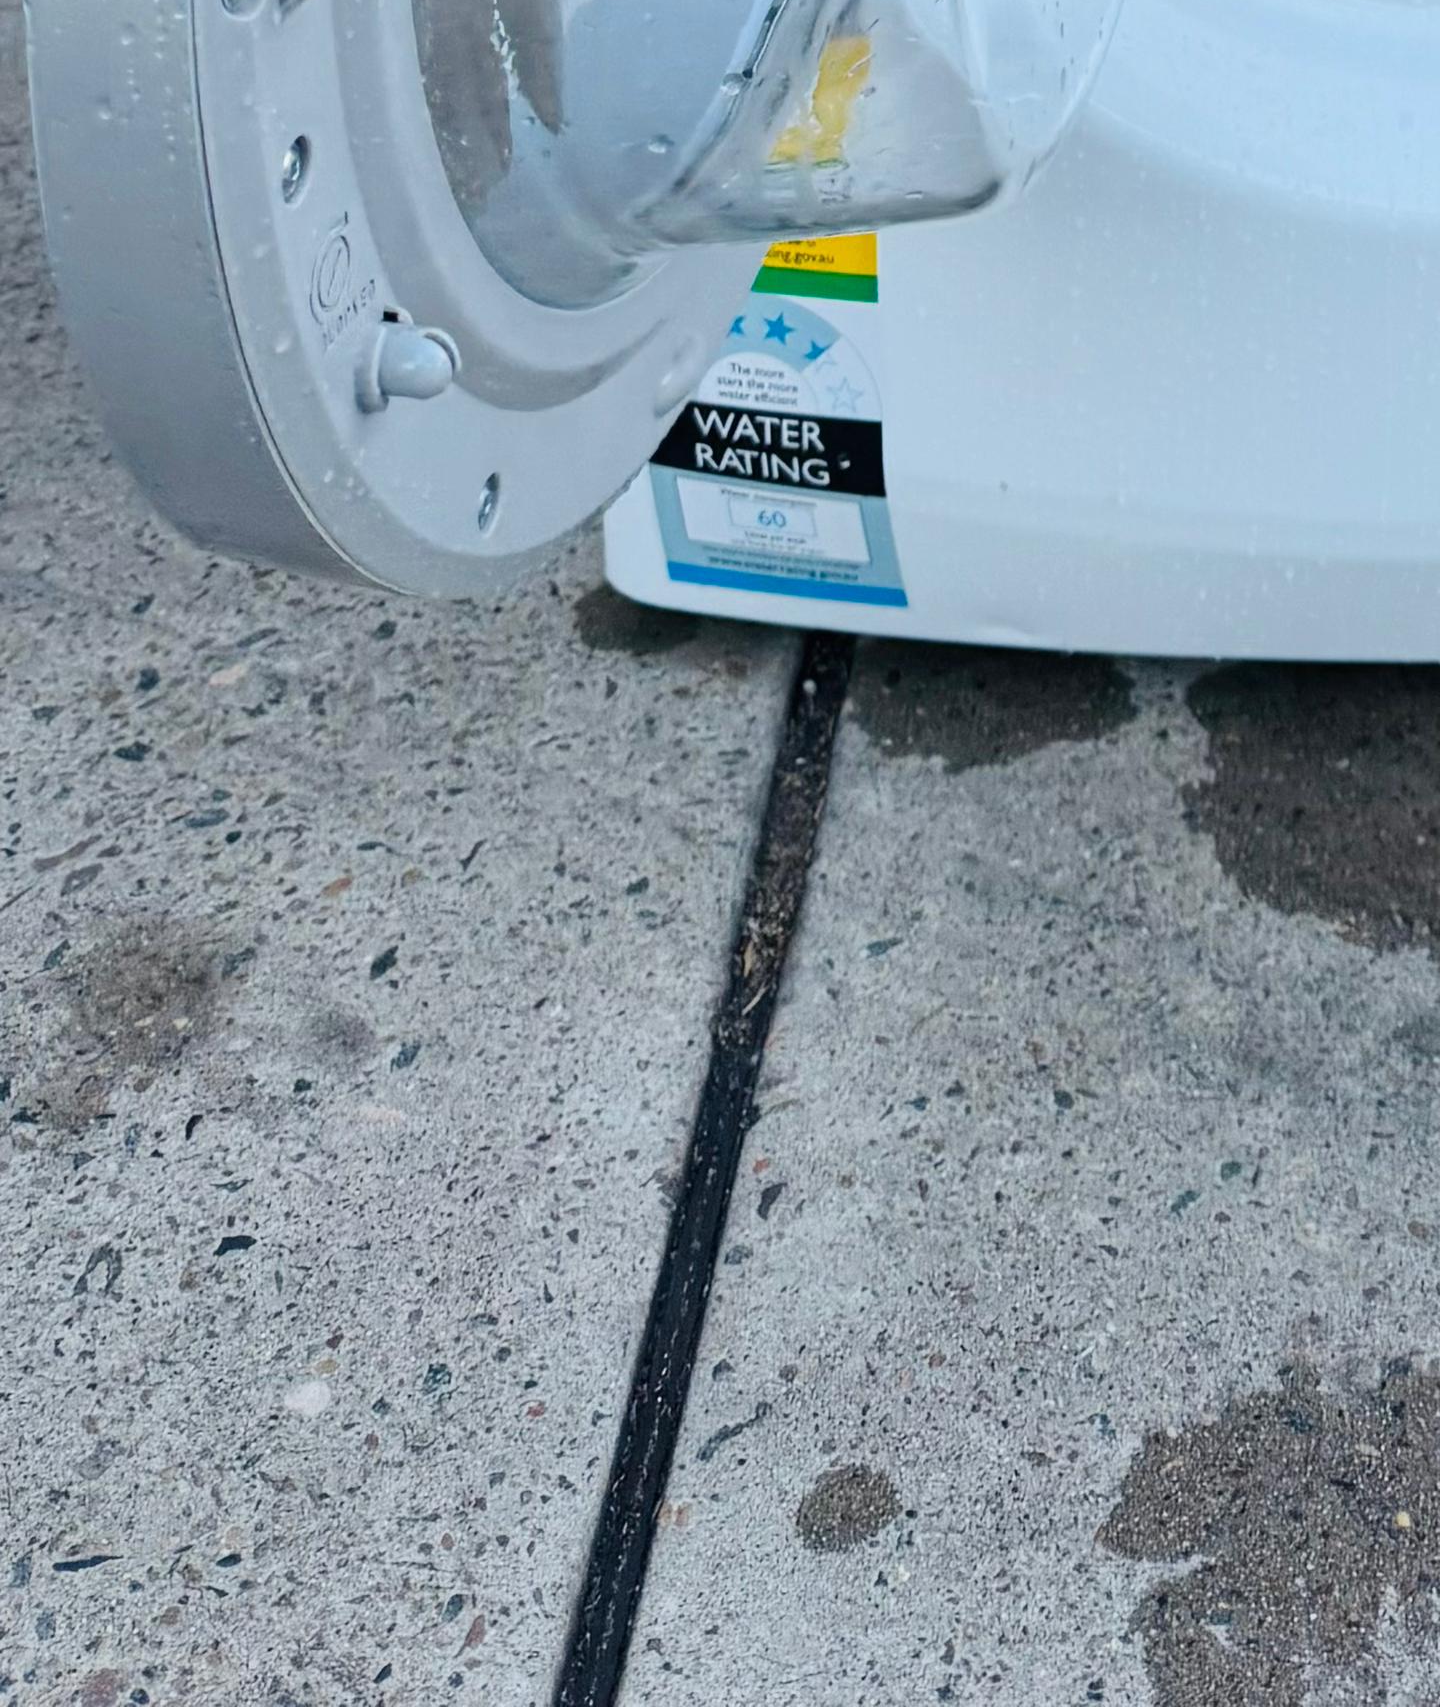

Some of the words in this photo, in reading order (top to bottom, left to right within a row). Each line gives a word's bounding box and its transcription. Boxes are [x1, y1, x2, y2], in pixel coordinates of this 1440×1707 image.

[730, 361, 751, 375] The
[692, 406, 826, 454] WATER
[693, 442, 832, 487] RATING
[757, 508, 787, 529] 60
